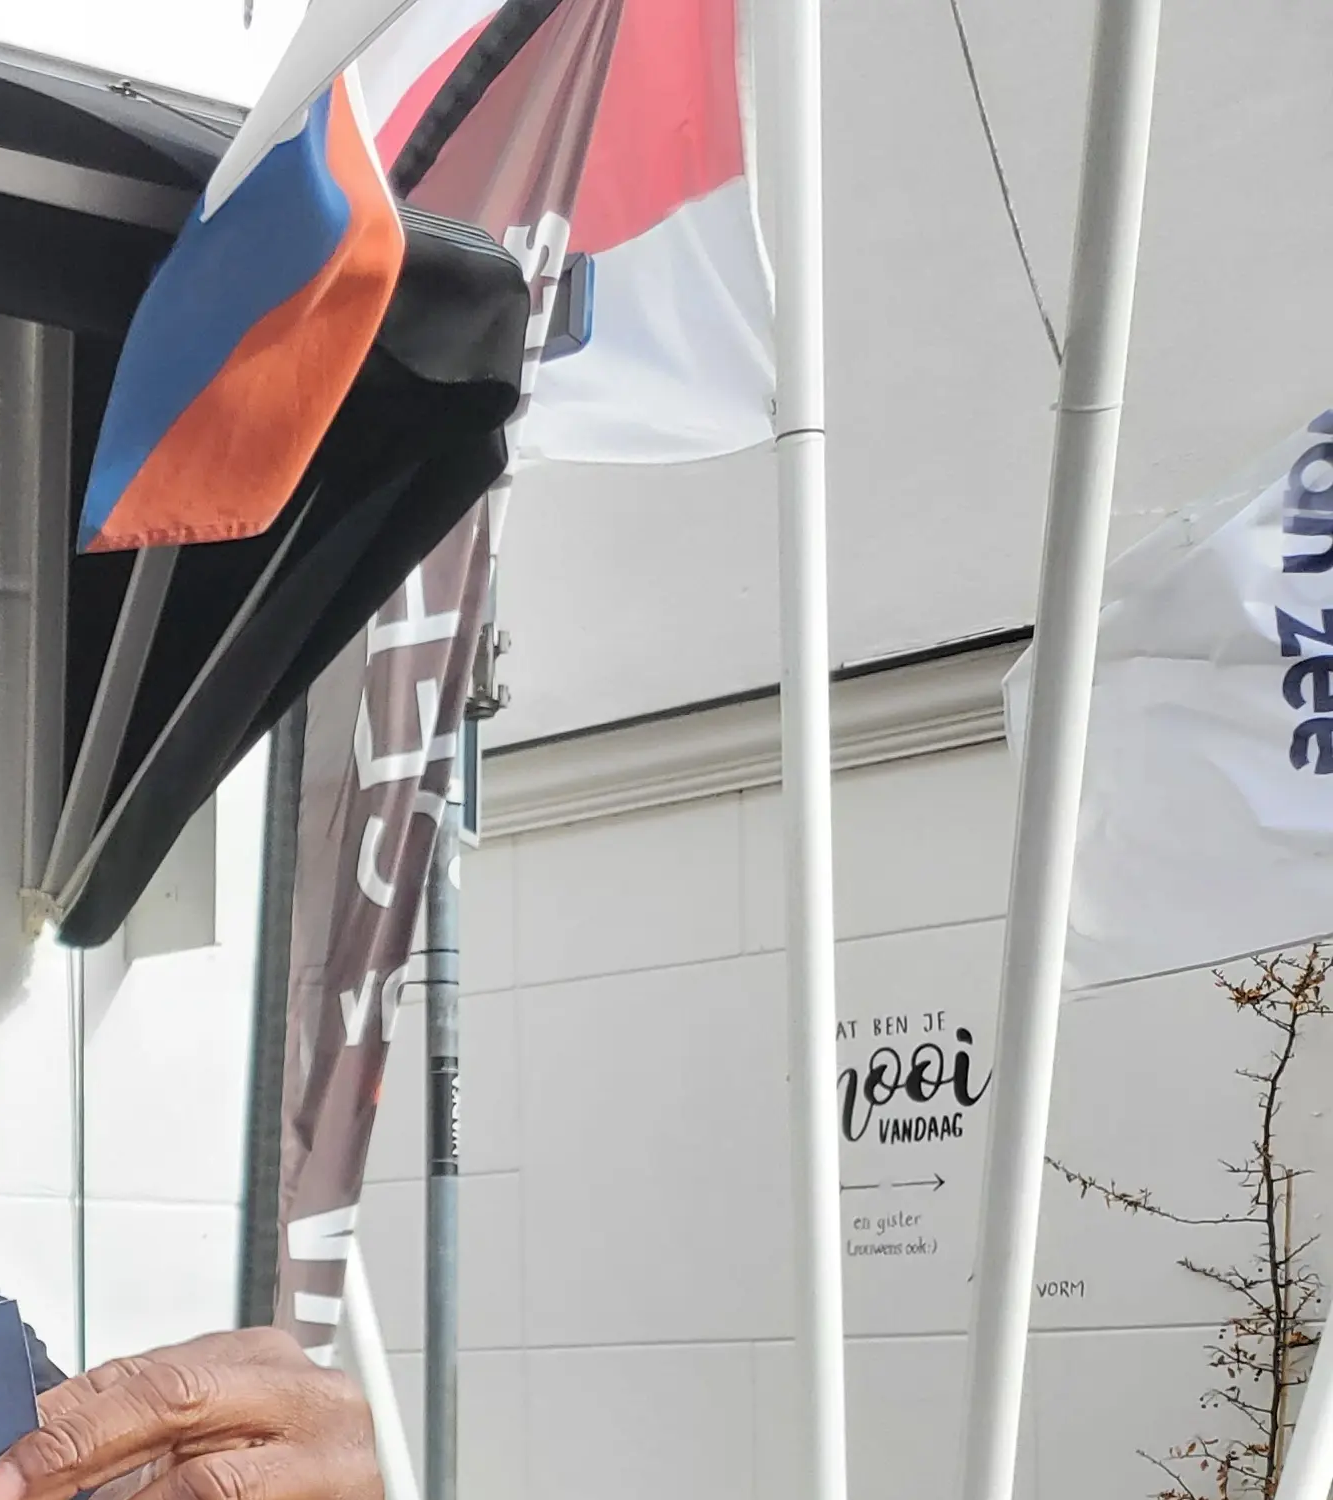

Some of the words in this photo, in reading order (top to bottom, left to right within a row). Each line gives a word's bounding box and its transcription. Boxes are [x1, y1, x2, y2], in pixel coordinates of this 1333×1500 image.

[836, 1021, 857, 1041] AT
[873, 1016, 908, 1037] BEN
[923, 1011, 945, 1032] JE
[879, 1112, 963, 1144] VANDAAG
[1037, 1280, 1085, 1298] VORM
